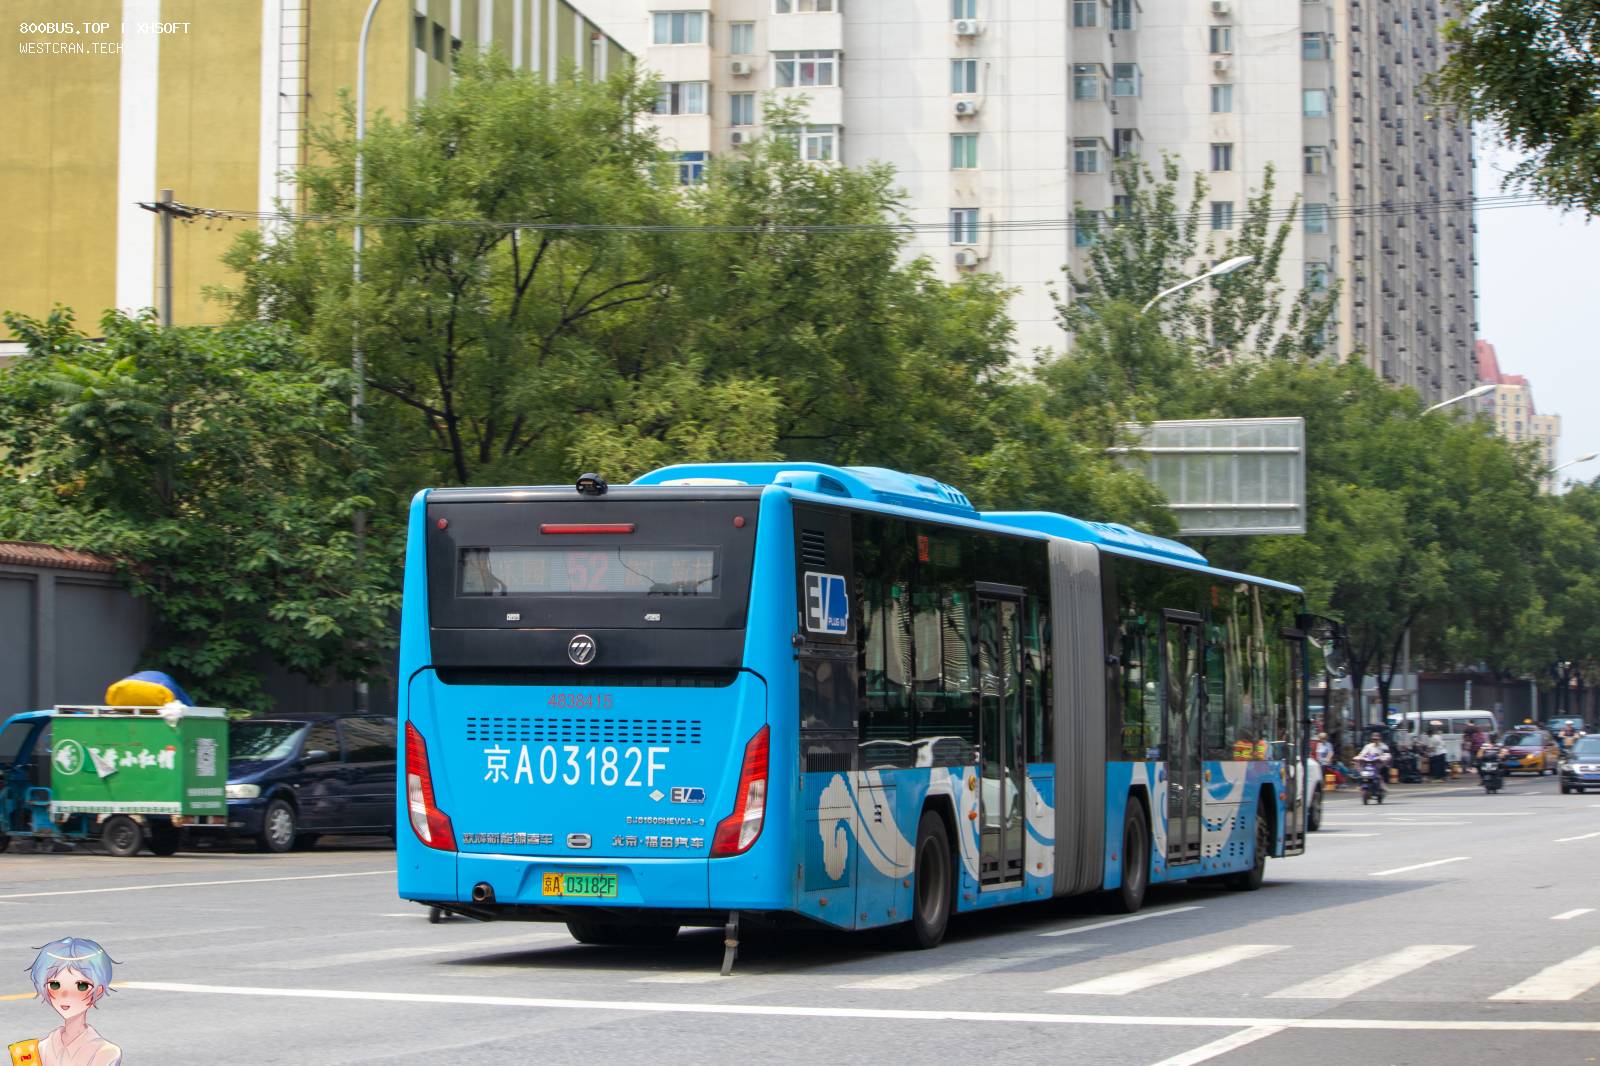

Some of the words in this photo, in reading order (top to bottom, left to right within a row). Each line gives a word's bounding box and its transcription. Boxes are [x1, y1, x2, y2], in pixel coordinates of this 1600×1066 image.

[568, 552, 609, 590] 52
[547, 693, 614, 709] 4838415
[483, 744, 670, 787] 京A03182F
